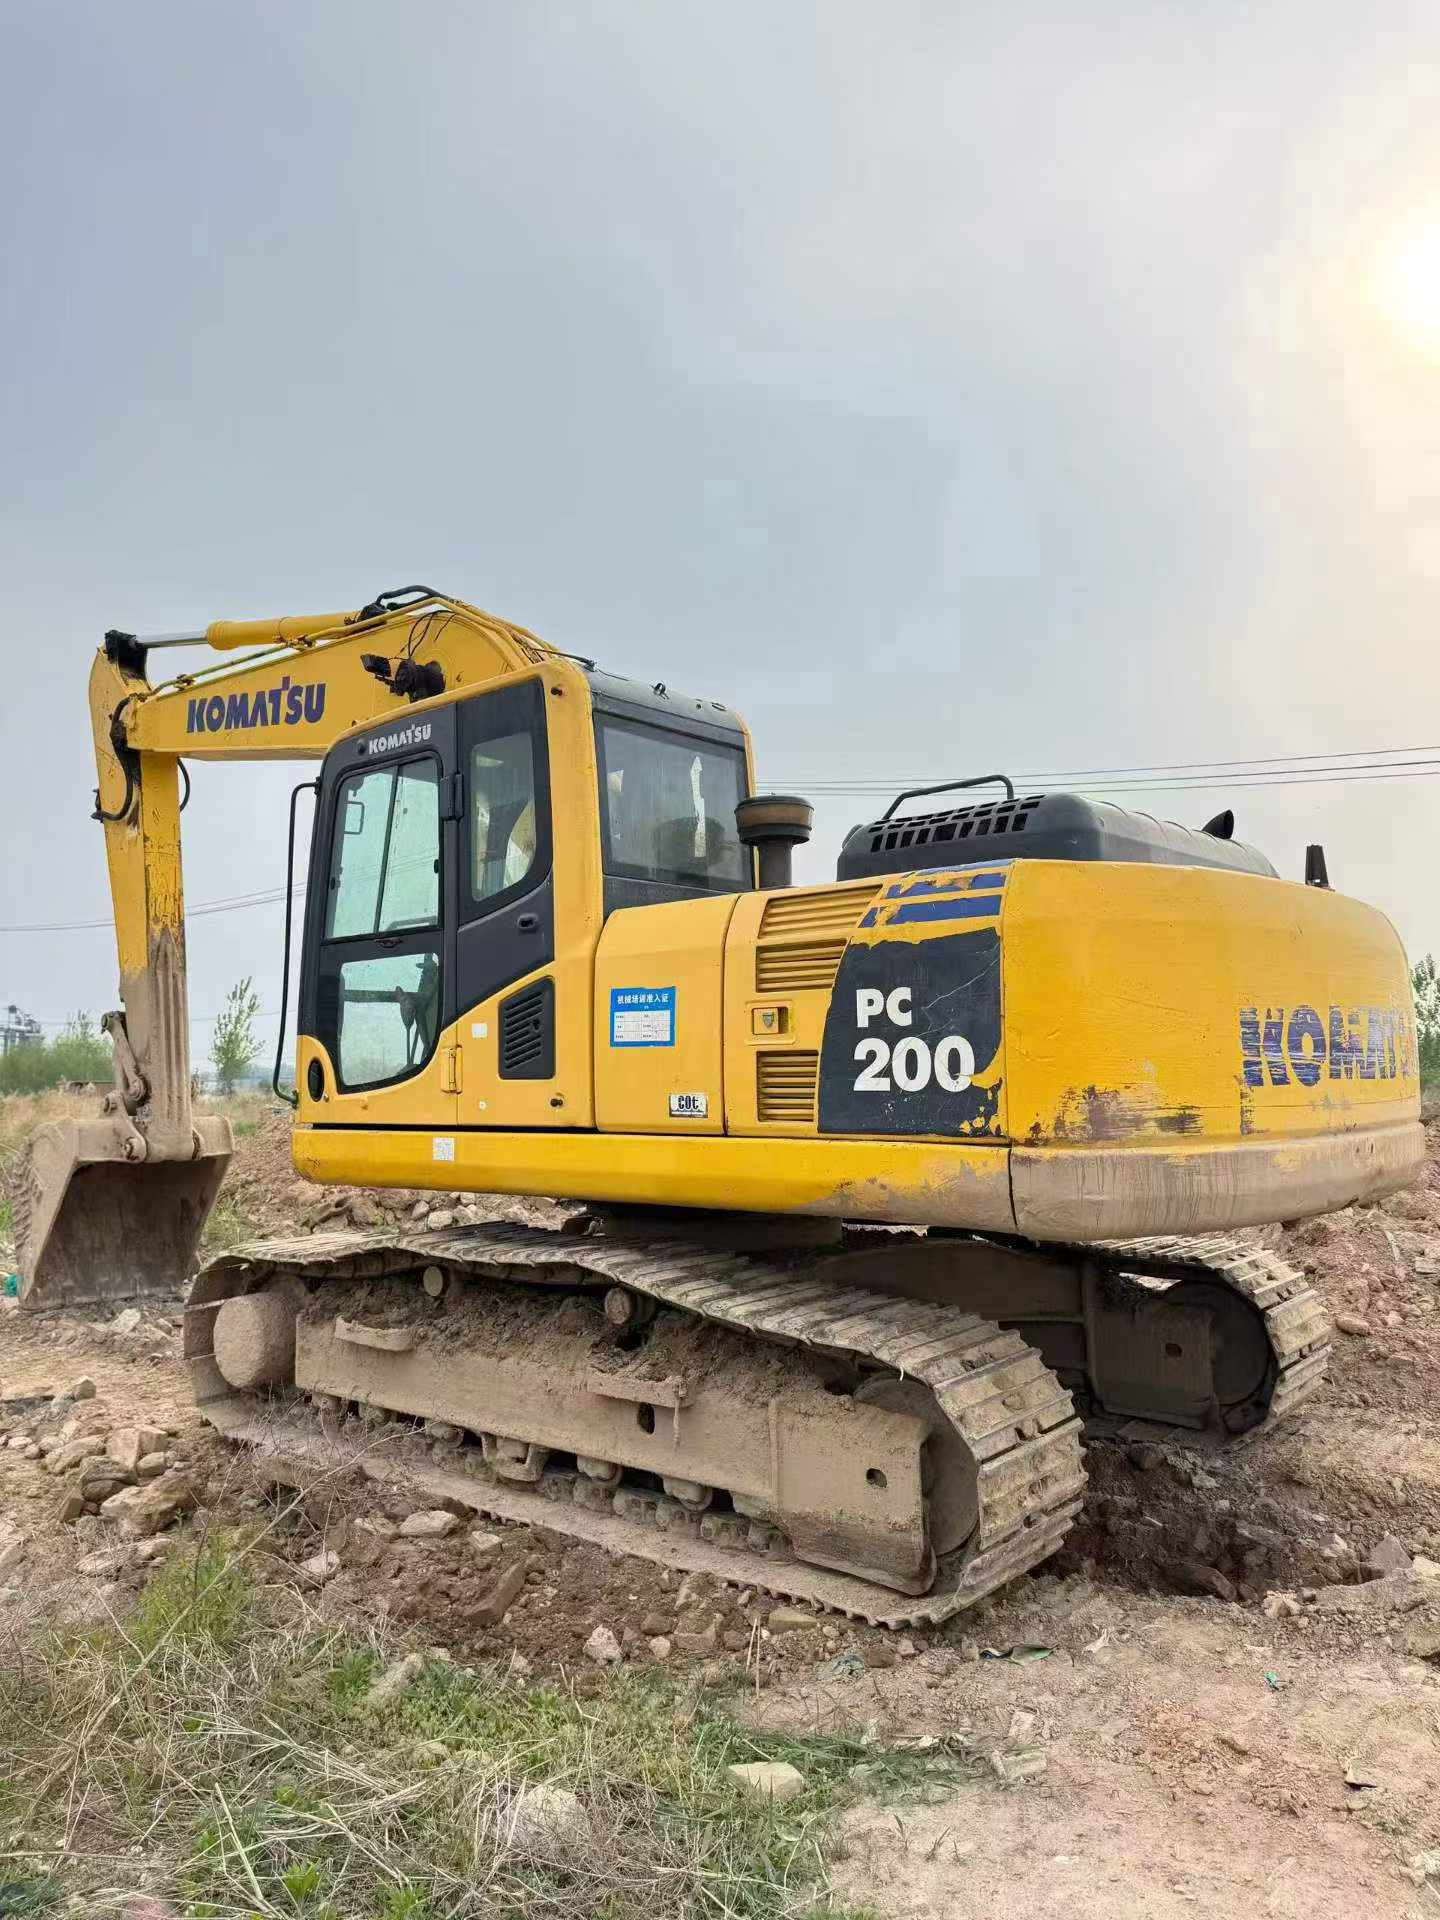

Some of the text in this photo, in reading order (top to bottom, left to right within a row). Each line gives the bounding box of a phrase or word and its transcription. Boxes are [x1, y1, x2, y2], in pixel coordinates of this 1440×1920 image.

[187, 676, 326, 733] KOMATSU
[368, 723, 432, 755] KOMATSU
[856, 986, 912, 1028] PC
[853, 1035, 975, 1093] 200
